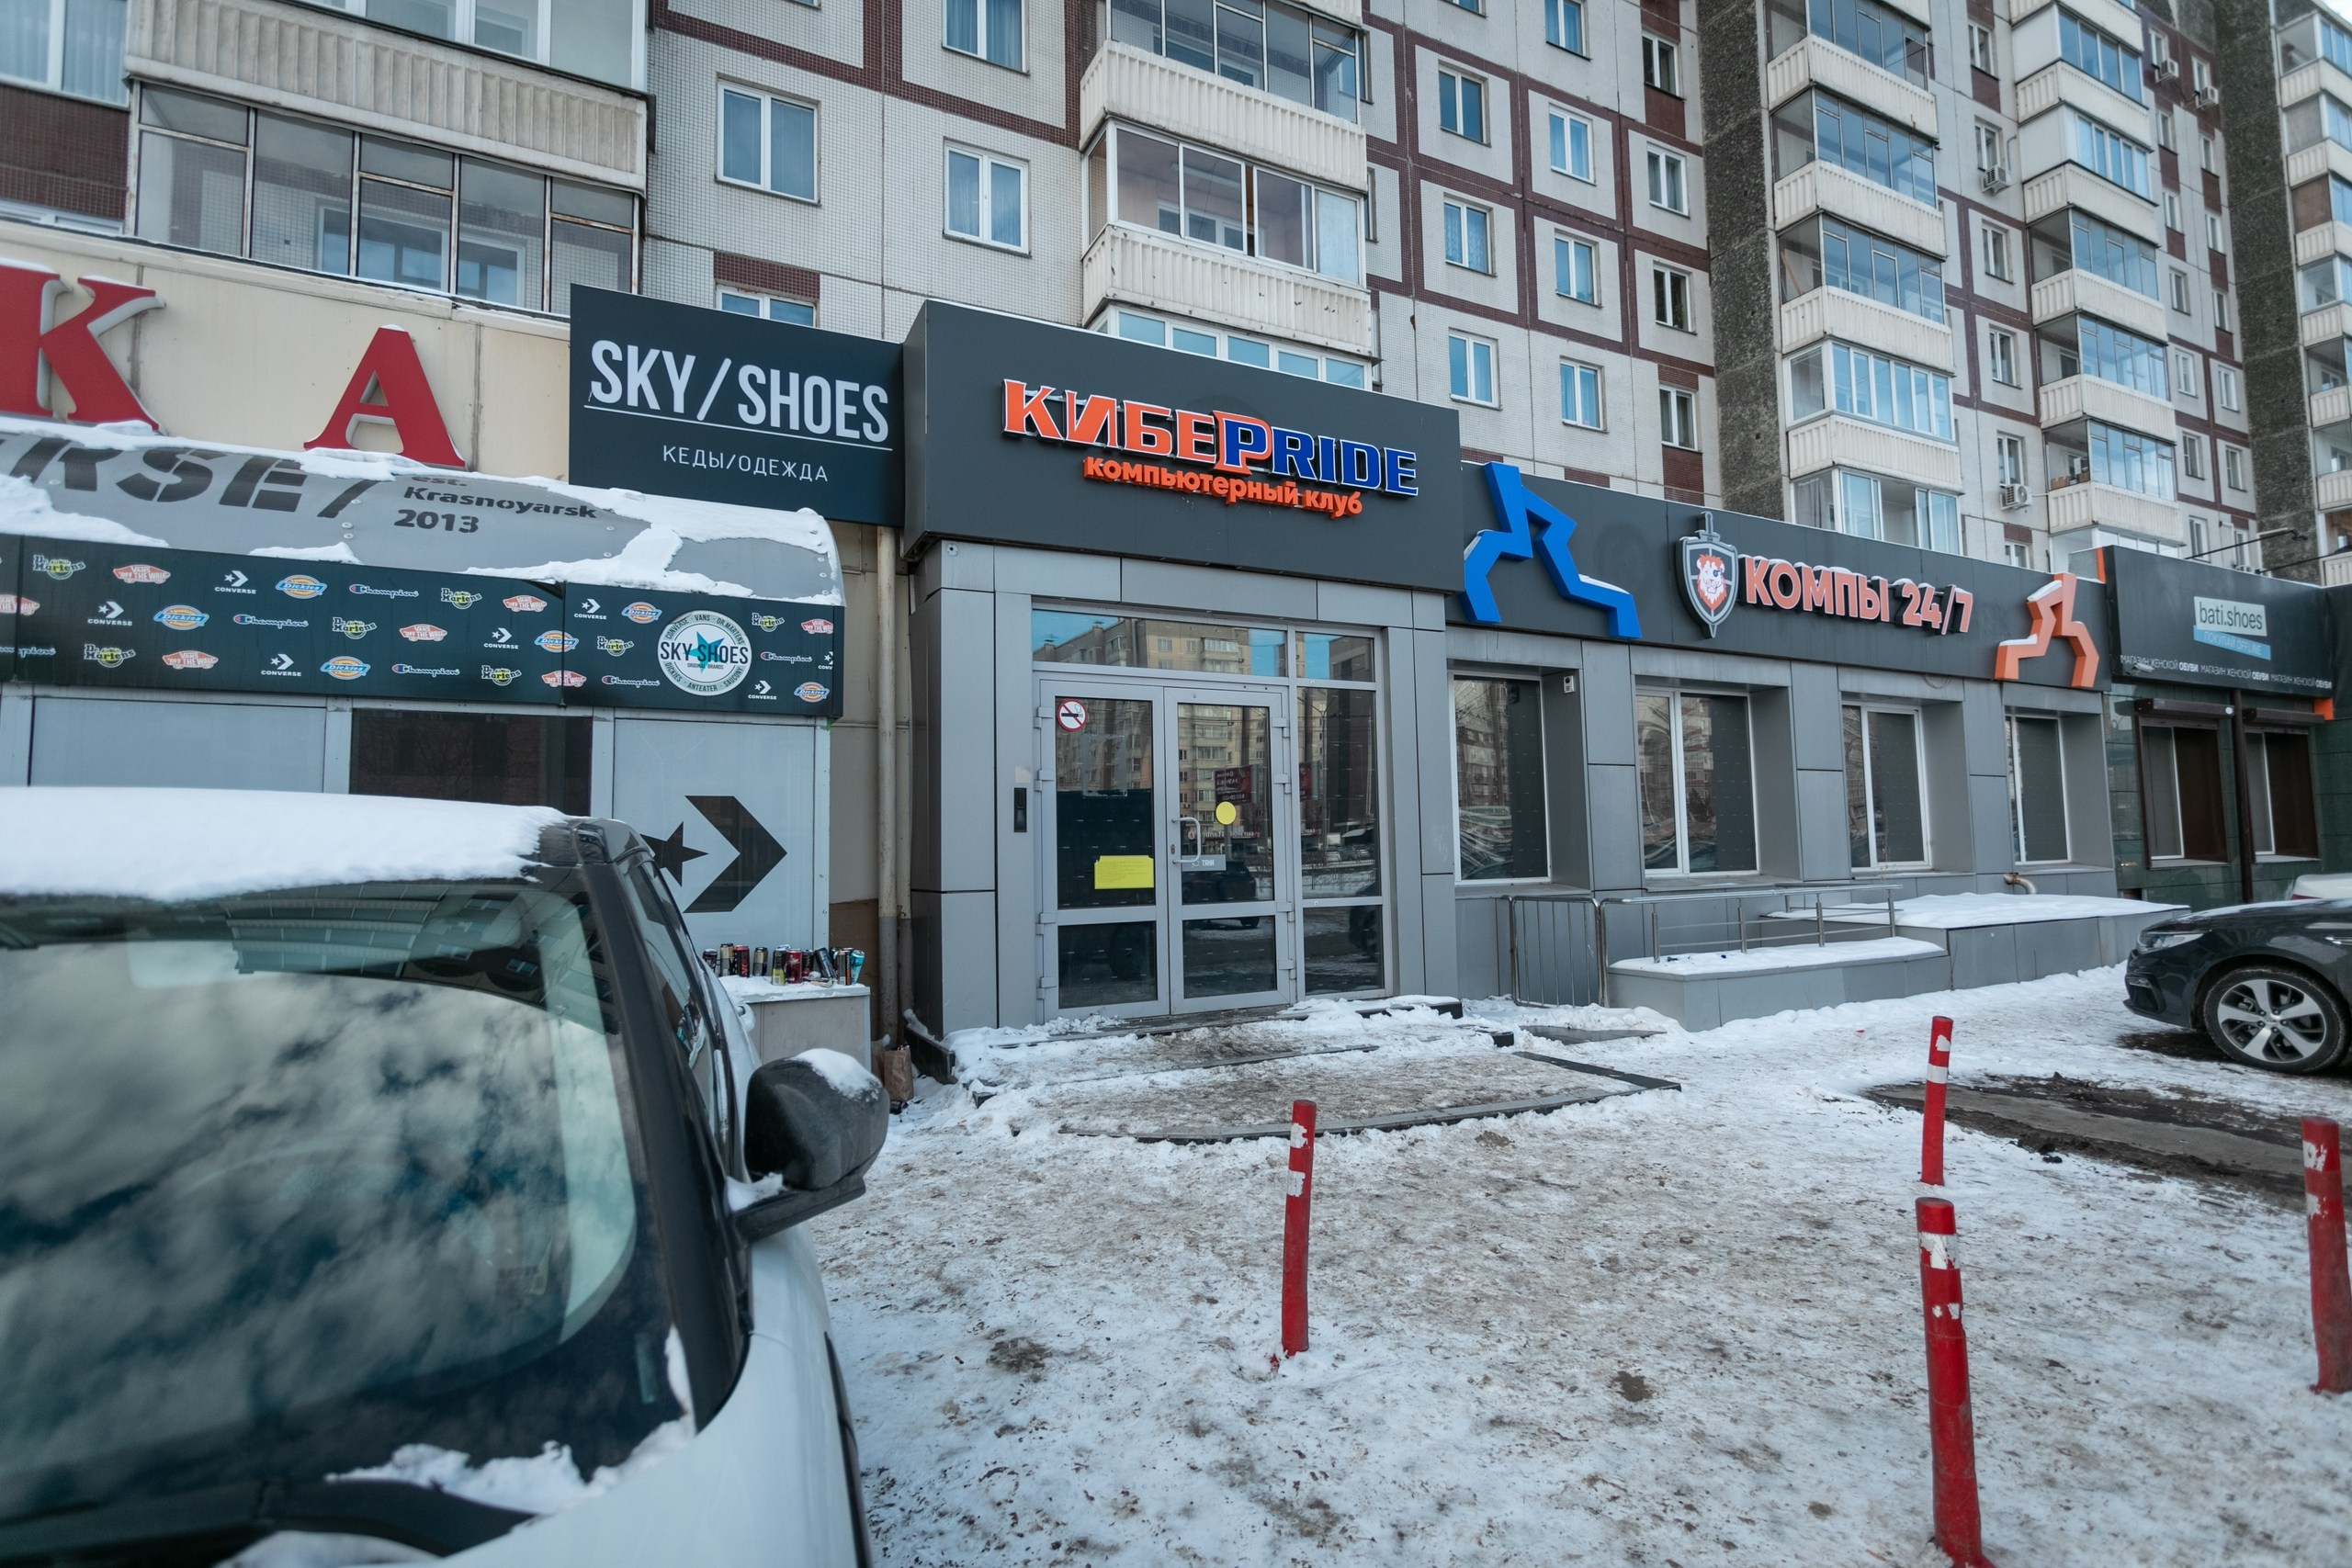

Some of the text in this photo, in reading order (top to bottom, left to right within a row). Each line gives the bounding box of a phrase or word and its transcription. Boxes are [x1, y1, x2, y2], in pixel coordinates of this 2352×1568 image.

[591, 339, 889, 443] SKY/SHOES
[662, 444, 829, 482] КЕДЫ/ОДЕЖДА
[403, 486, 597, 519] Krasnoyarsk
[1300, 485, 1363, 521] клуб
[393, 508, 480, 534] 2013
[33, 561, 86, 572] Martens
[134, 571, 148, 581] THE
[214, 586, 256, 594] CONVERSE
[349, 583, 419, 599] Champion
[1742, 555, 1974, 636] КОМПЫ 24/7
[441, 592, 482, 603] Martens
[162, 613, 202, 621] Dickies
[232, 614, 309, 629] Champion
[752, 616, 785, 626] Martens
[2199, 600, 2264, 630] bati.shoes
[87, 618, 133, 626] CONVERSE
[333, 622, 378, 632] Martens
[665, 618, 689, 640] CONVERSE
[694, 614, 711, 622] VANS
[597, 640, 634, 650] Martens
[84, 649, 136, 660] Martens
[660, 641, 749, 665] SKY SHOES
[760, 651, 812, 664] Champion
[183, 657, 197, 666] THE
[2178, 661, 2199, 672] ОБУВИ
[392, 664, 460, 678] Champion
[481, 669, 522, 680] Martens
[664, 661, 744, 693] DICKIES ANTEATER SAUCONY
[602, 675, 661, 688] Champion
